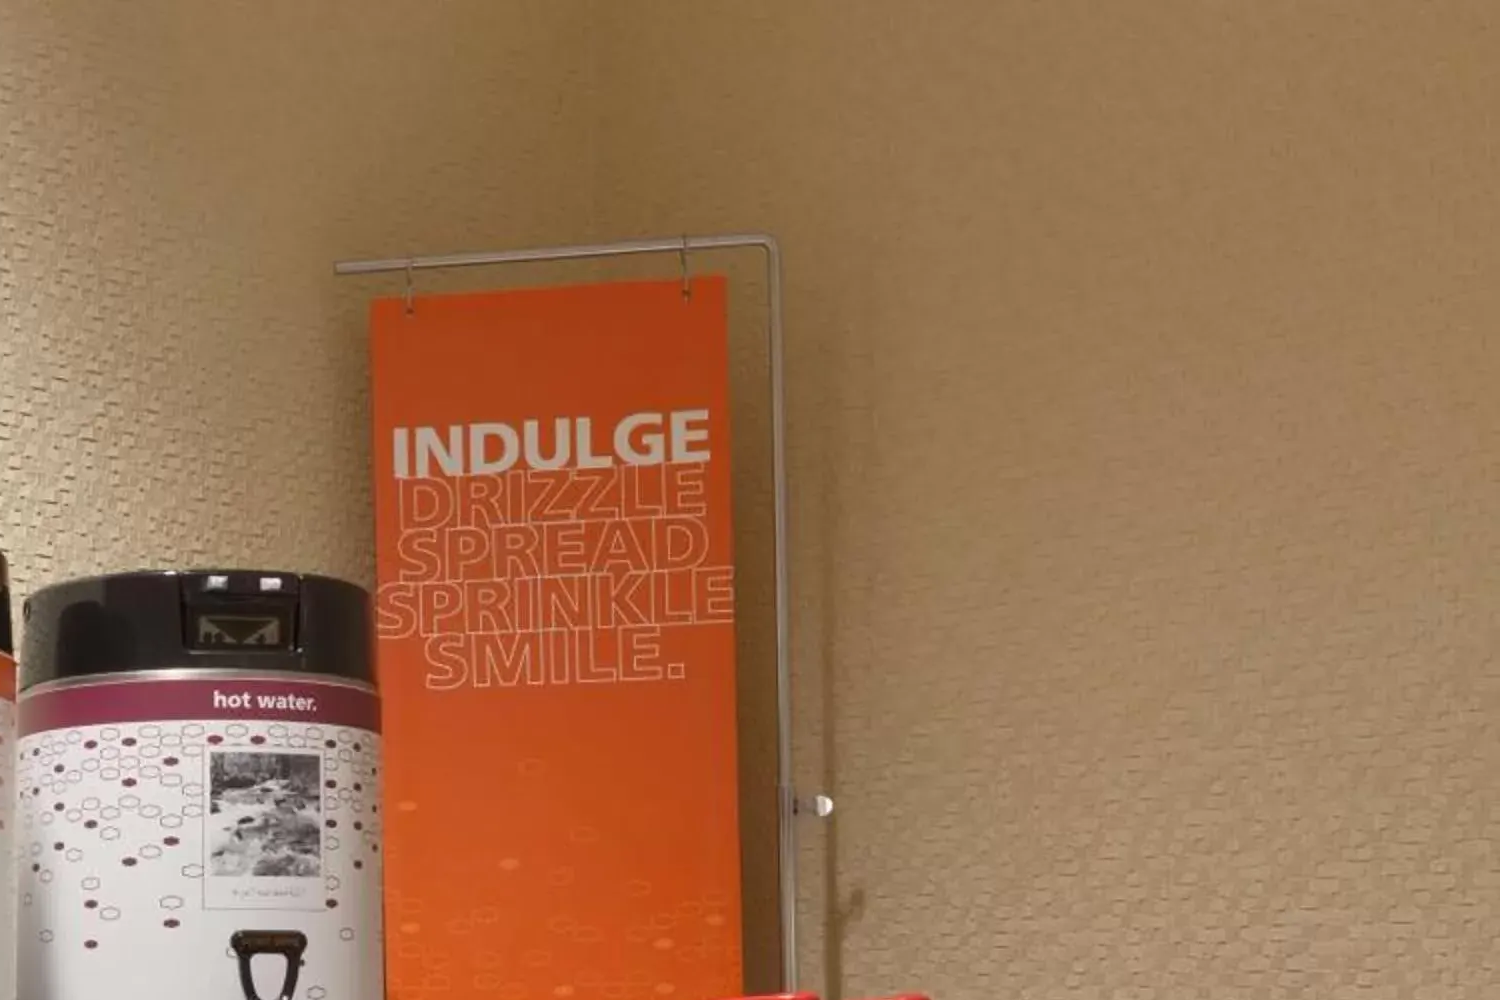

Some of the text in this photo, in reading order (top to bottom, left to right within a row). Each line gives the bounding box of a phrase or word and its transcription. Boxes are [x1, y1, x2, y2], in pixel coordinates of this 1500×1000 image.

[393, 409, 711, 479] INDULGE
[399, 463, 706, 531] DRIZZLE
[397, 515, 710, 584] SPREAD
[376, 566, 735, 638] SPRINKLE
[424, 625, 686, 690] SMILE.
[213, 689, 317, 712] hot water.
